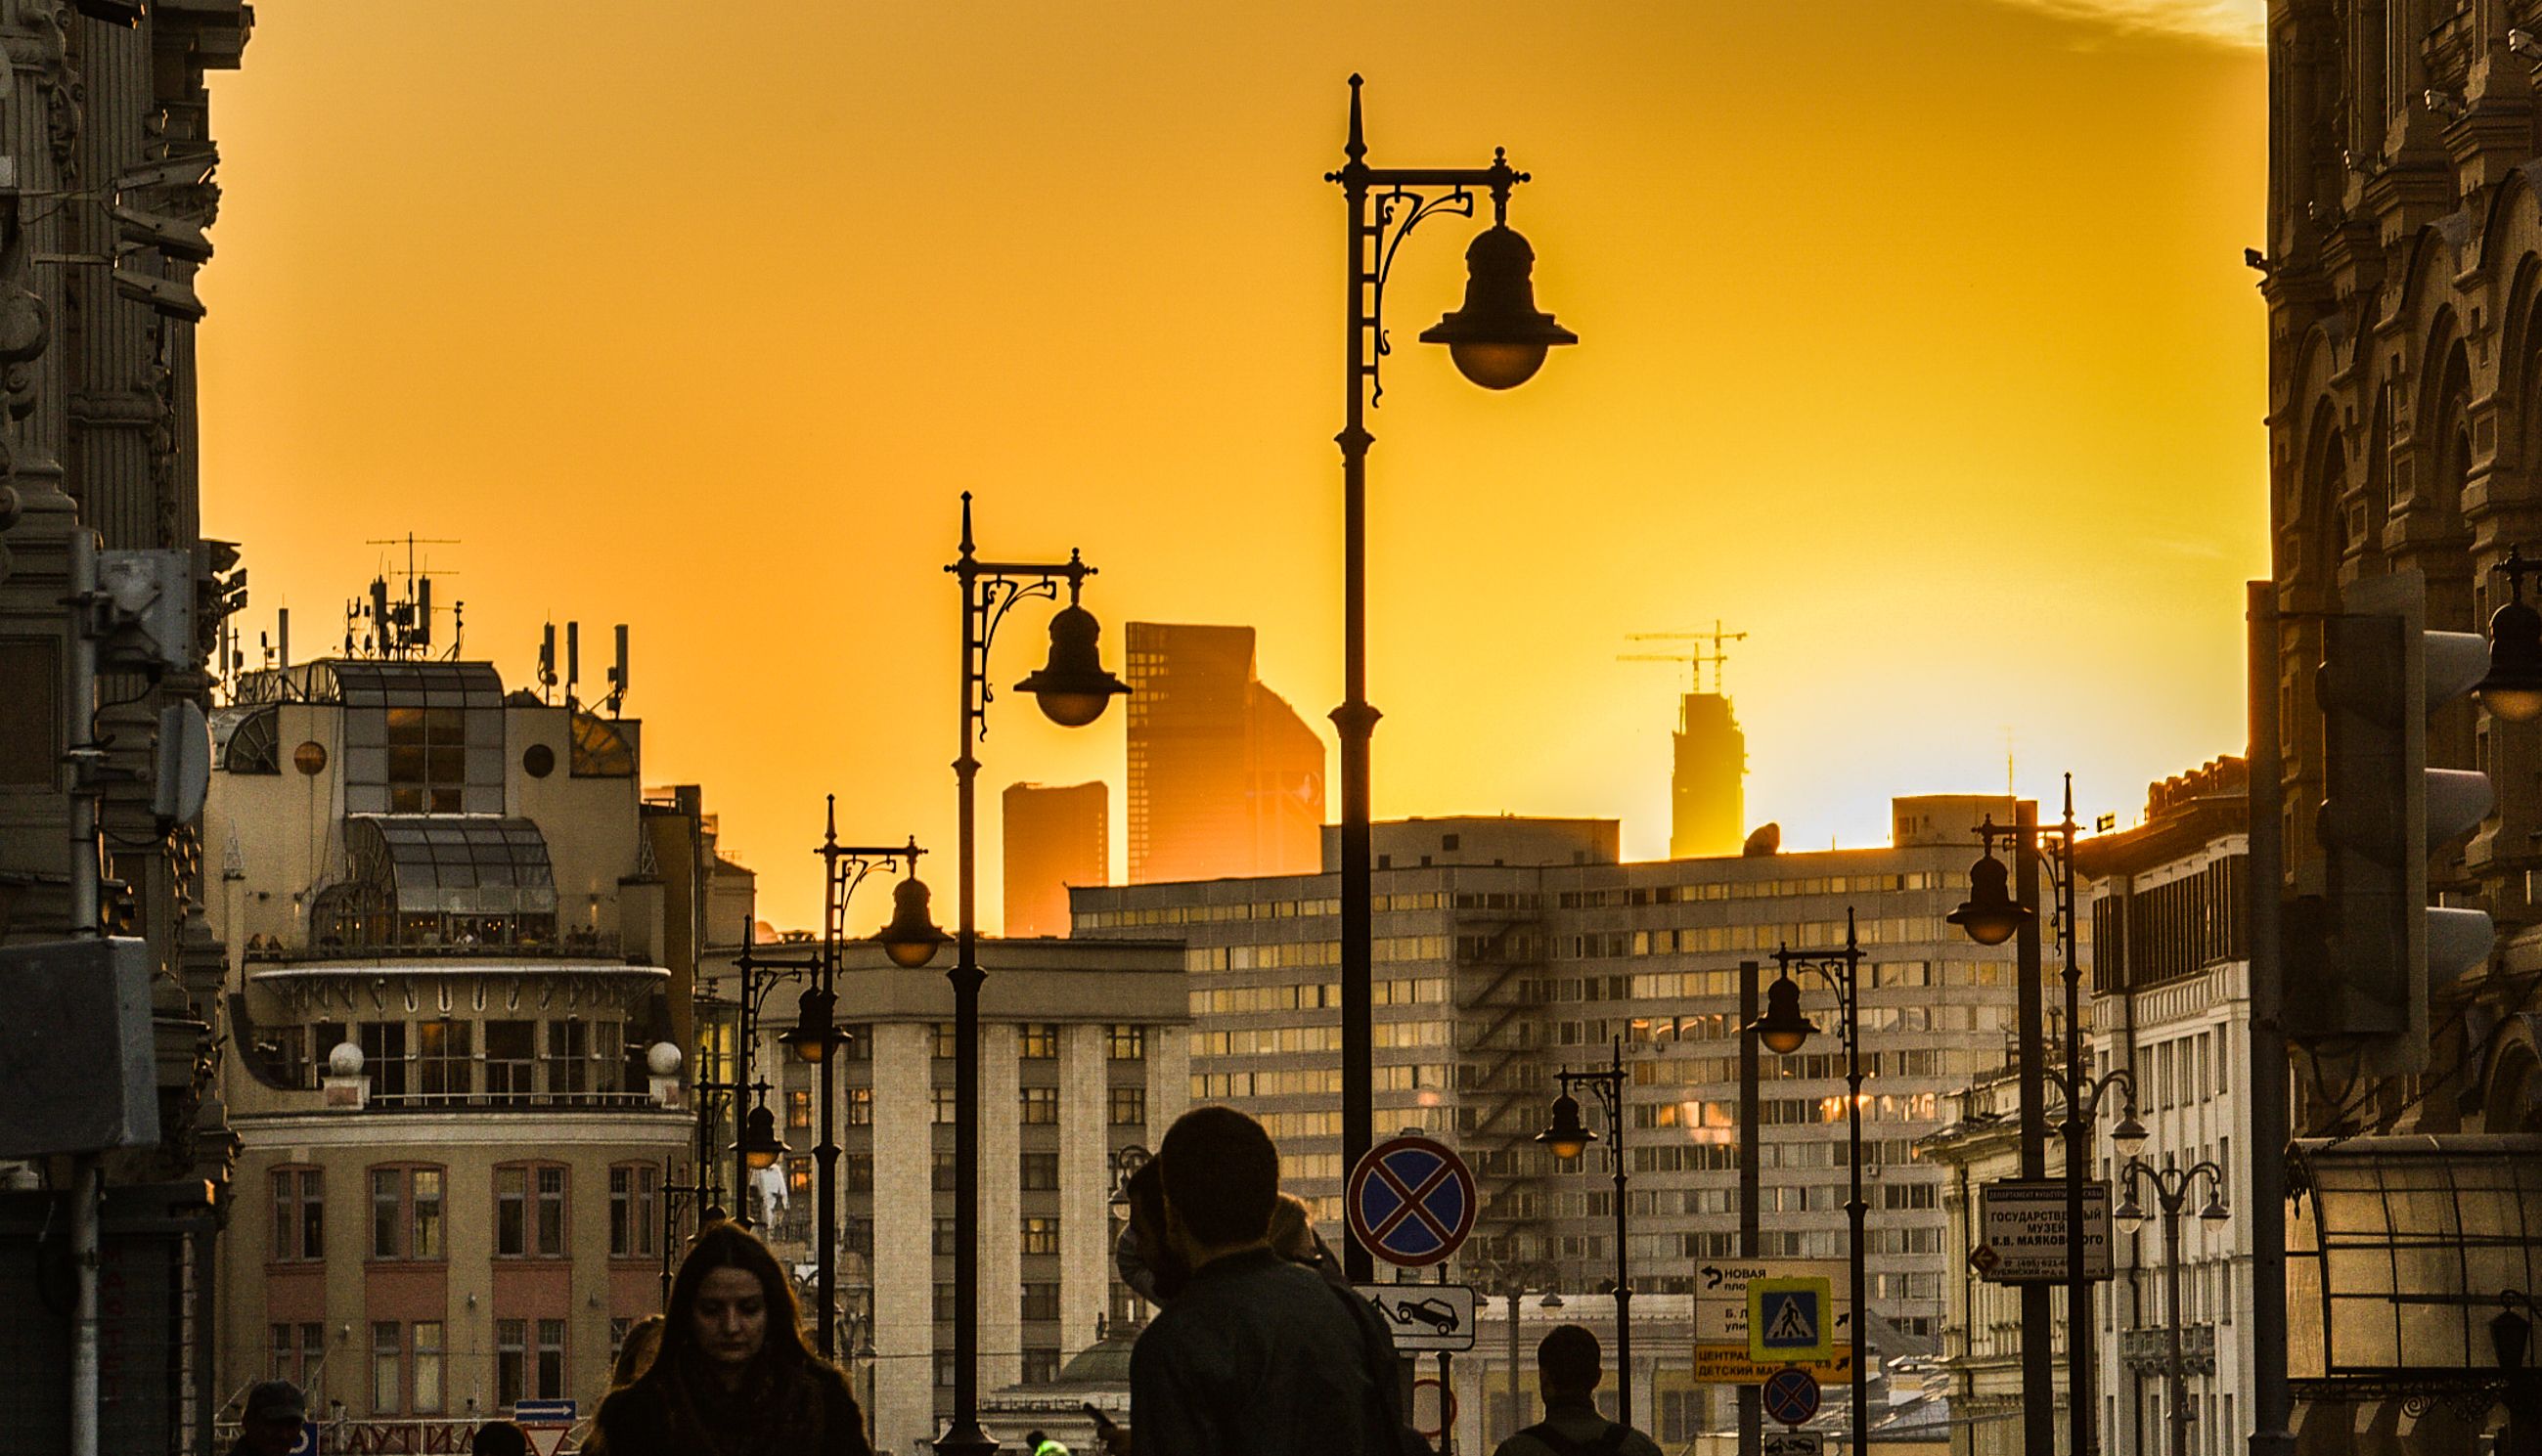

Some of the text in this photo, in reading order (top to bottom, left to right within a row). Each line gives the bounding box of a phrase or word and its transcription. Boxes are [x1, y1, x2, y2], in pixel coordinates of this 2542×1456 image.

[1990, 1209, 2102, 1222] ГОСУДАРСТВЕЫЙ
[2027, 1222, 2066, 1233] МУЗЕЙ
[2017, 1236, 2104, 1246] МАЯКОВОГО
[1724, 1269, 1766, 1279] НОВАЯ
